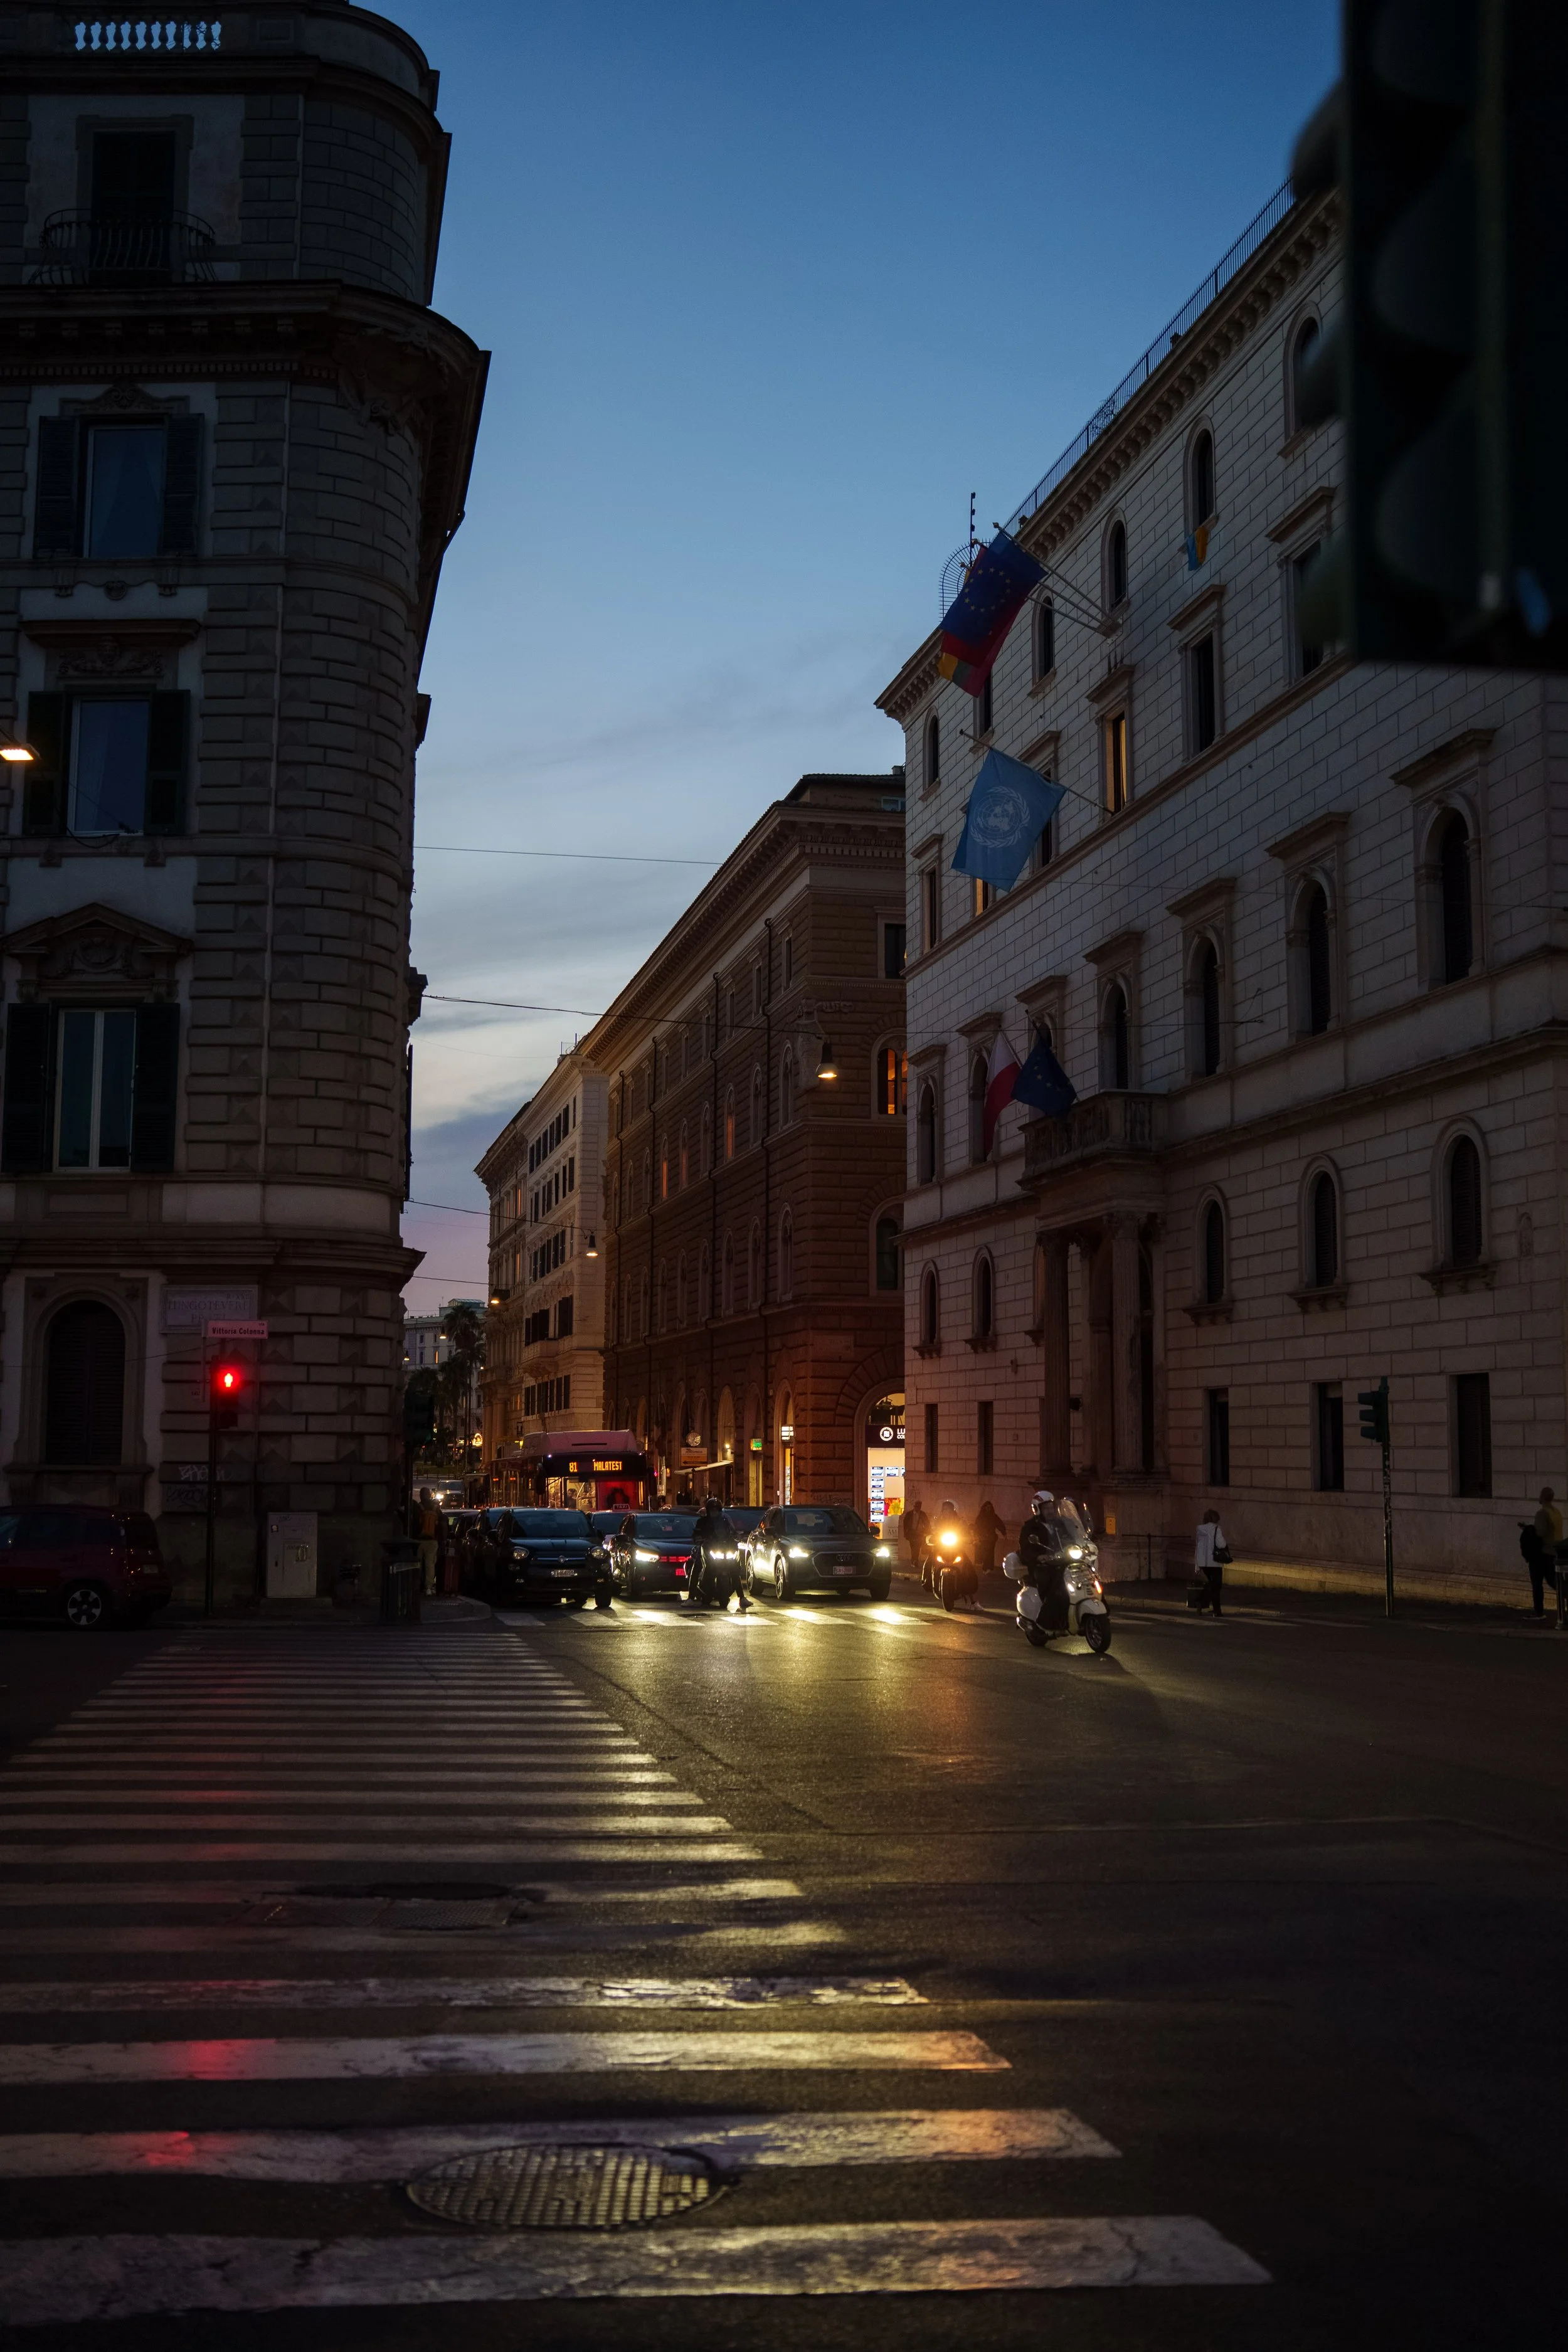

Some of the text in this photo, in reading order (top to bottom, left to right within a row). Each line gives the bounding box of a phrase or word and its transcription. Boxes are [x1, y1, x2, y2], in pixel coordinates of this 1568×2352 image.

[169, 1300, 248, 1310] LUNGOTEVERE
[569, 1461, 622, 1472] 81 MALATEST
